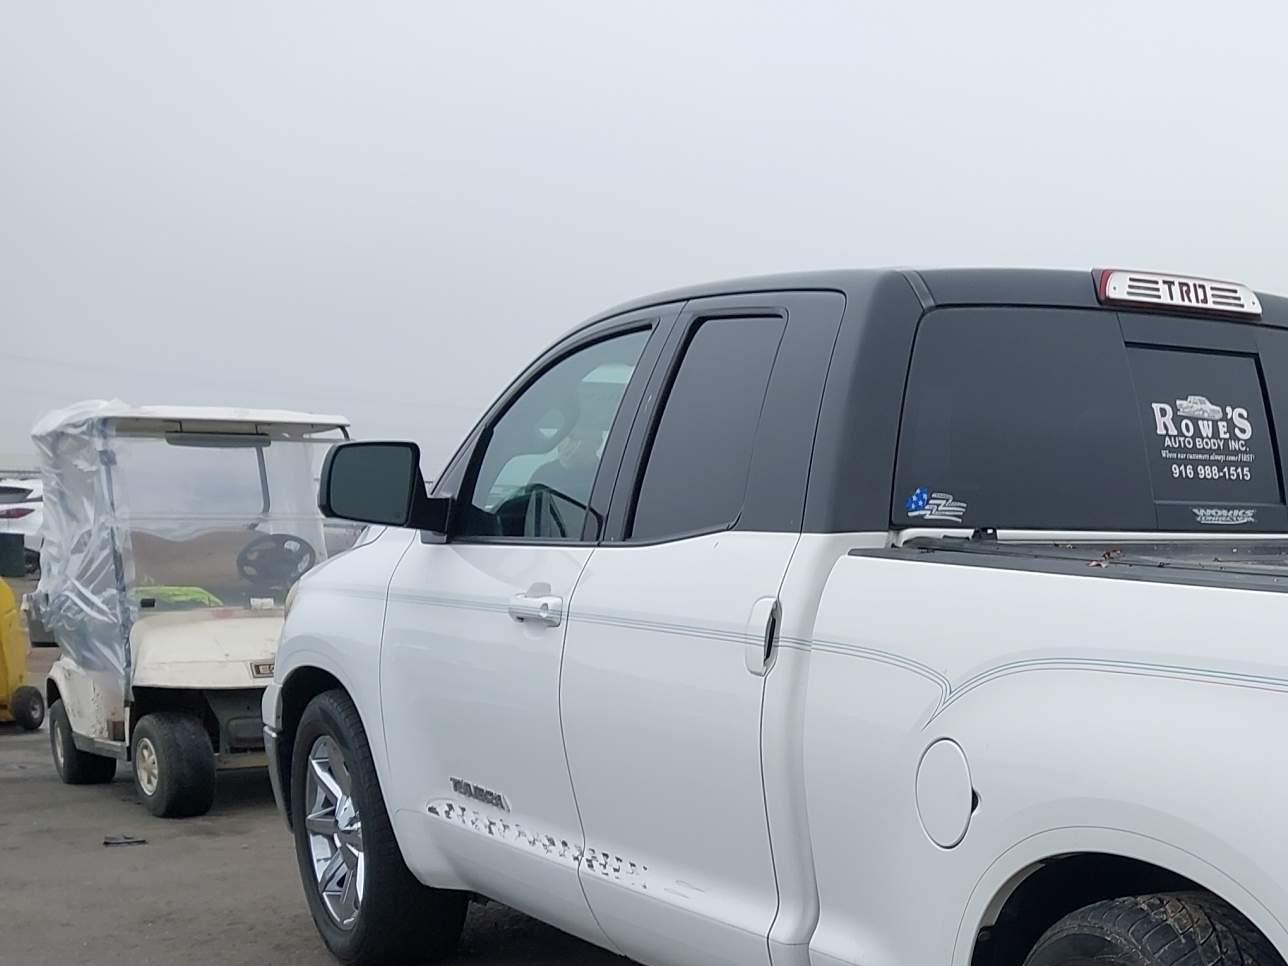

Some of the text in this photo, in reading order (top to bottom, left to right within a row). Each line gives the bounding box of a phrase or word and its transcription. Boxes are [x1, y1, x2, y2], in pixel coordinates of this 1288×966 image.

[1162, 279, 1208, 305] TRD
[1164, 436, 1250, 452] AUTO BODY INC.
[1171, 463, 1251, 481] 916 988-1515
